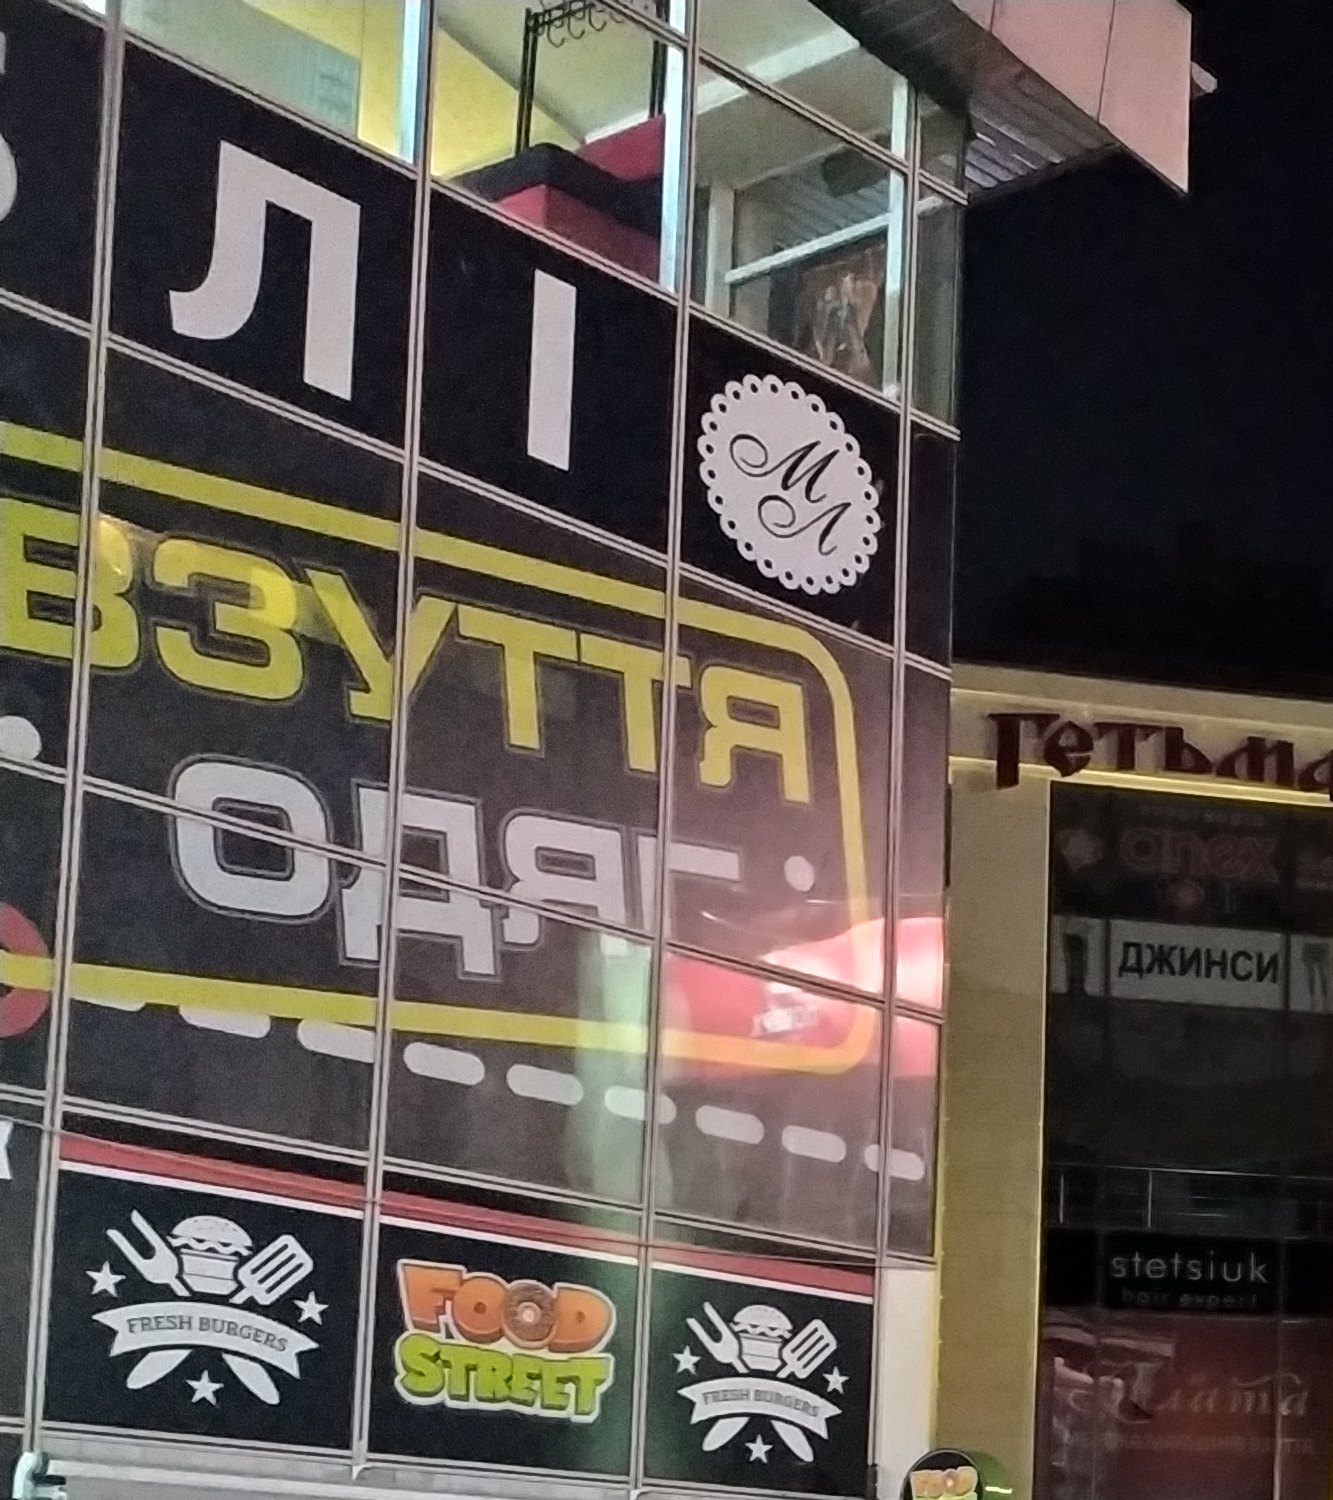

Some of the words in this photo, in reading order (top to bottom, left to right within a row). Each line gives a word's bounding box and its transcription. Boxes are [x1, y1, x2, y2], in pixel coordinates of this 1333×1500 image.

[0, 498, 810, 803] ВЗУТТЯ
[1118, 941, 1279, 984] ДЖИНСИ
[1110, 1250, 1268, 1285] stetsiuk
[126, 1315, 193, 1334] FRESH
[198, 1316, 289, 1352] BURGERS
[400, 1262, 613, 1353] FOOD
[400, 1332, 609, 1416] STREET
